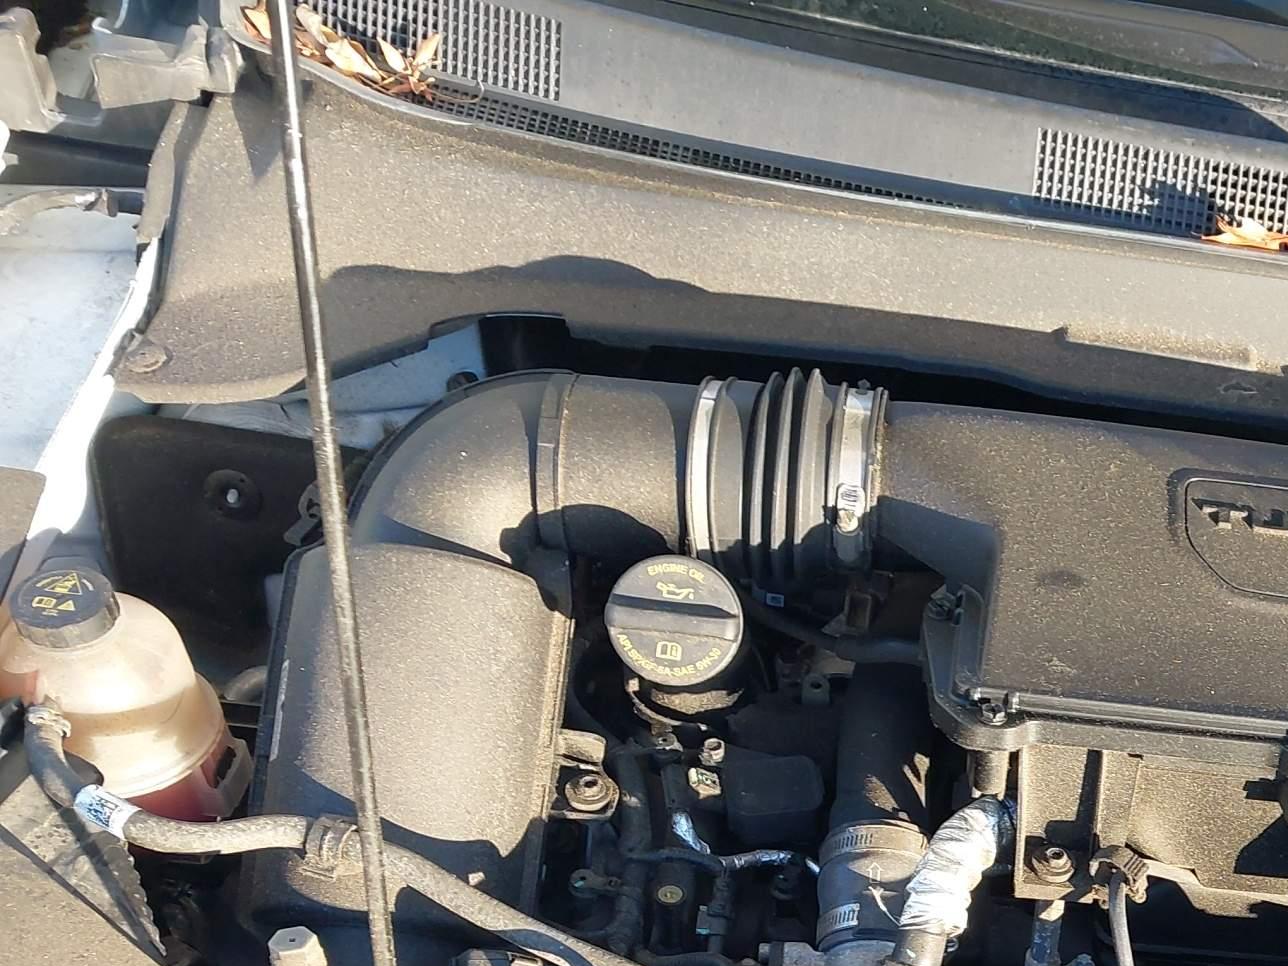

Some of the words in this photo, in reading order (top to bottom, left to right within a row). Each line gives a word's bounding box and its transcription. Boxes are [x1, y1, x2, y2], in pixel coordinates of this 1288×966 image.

[647, 562, 689, 576] ENGINE
[688, 567, 706, 584] OIL
[616, 633, 632, 652] API
